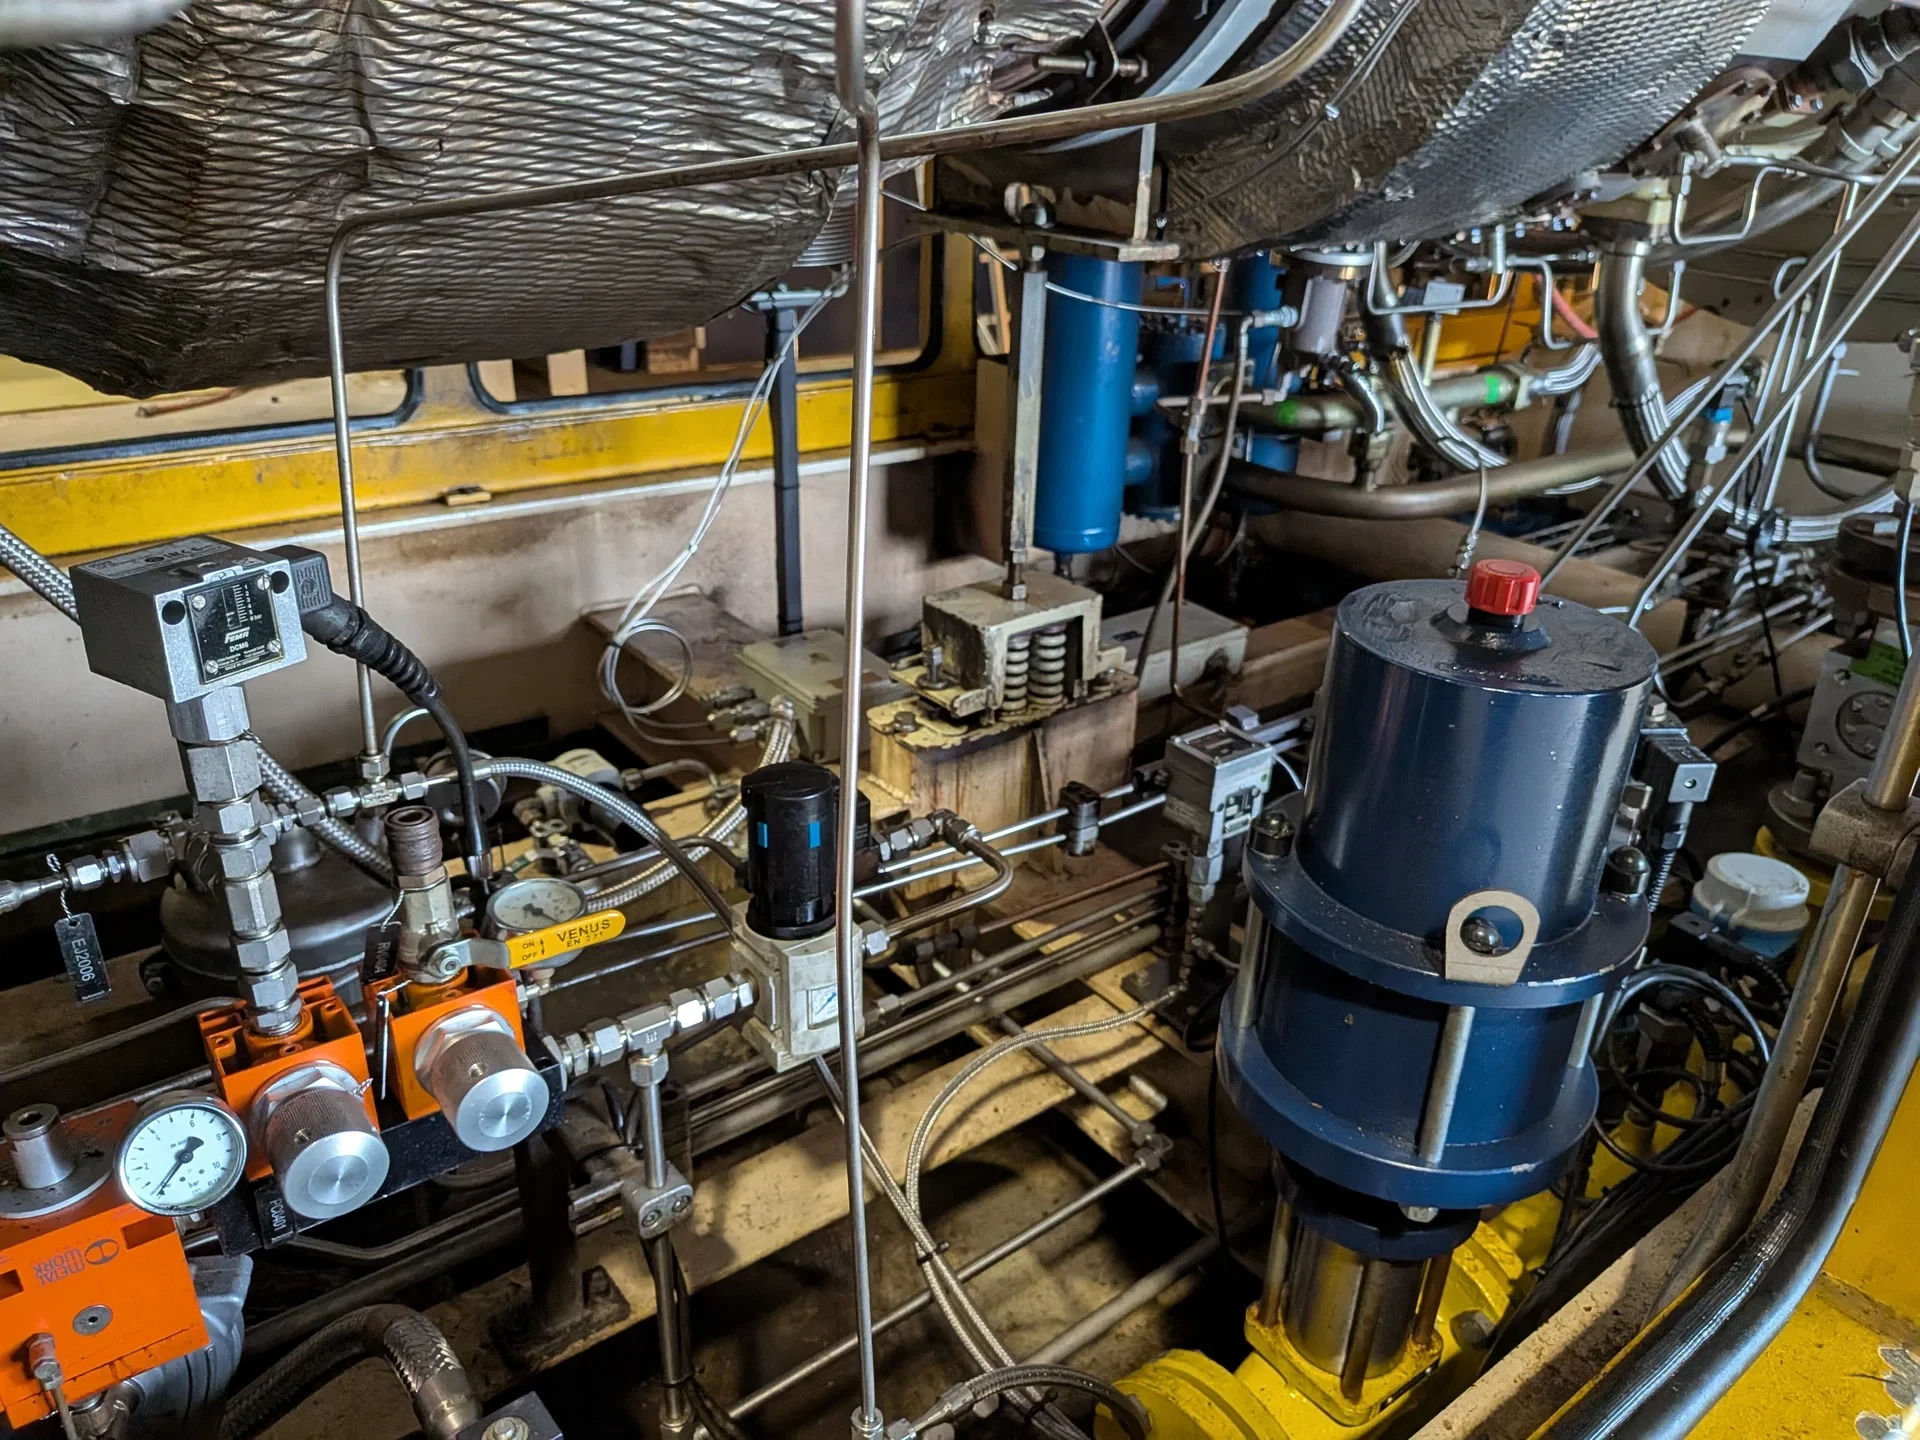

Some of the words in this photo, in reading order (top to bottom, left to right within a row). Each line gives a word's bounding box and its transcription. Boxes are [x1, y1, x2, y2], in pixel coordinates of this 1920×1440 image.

[557, 919, 611, 942] VENUS
[521, 940, 535, 949] ON
[566, 938, 581, 948] EN
[72, 938, 96, 982] EJ2006
[521, 950, 538, 961] OFF
[189, 1120, 195, 1128] 6
[216, 1132, 222, 1141] 8
[143, 1162, 150, 1170] 2
[212, 1160, 221, 1169] 10
[187, 1179, 200, 1188] bar
[31, 1248, 84, 1277] WORK
[36, 1260, 86, 1286] METAL
